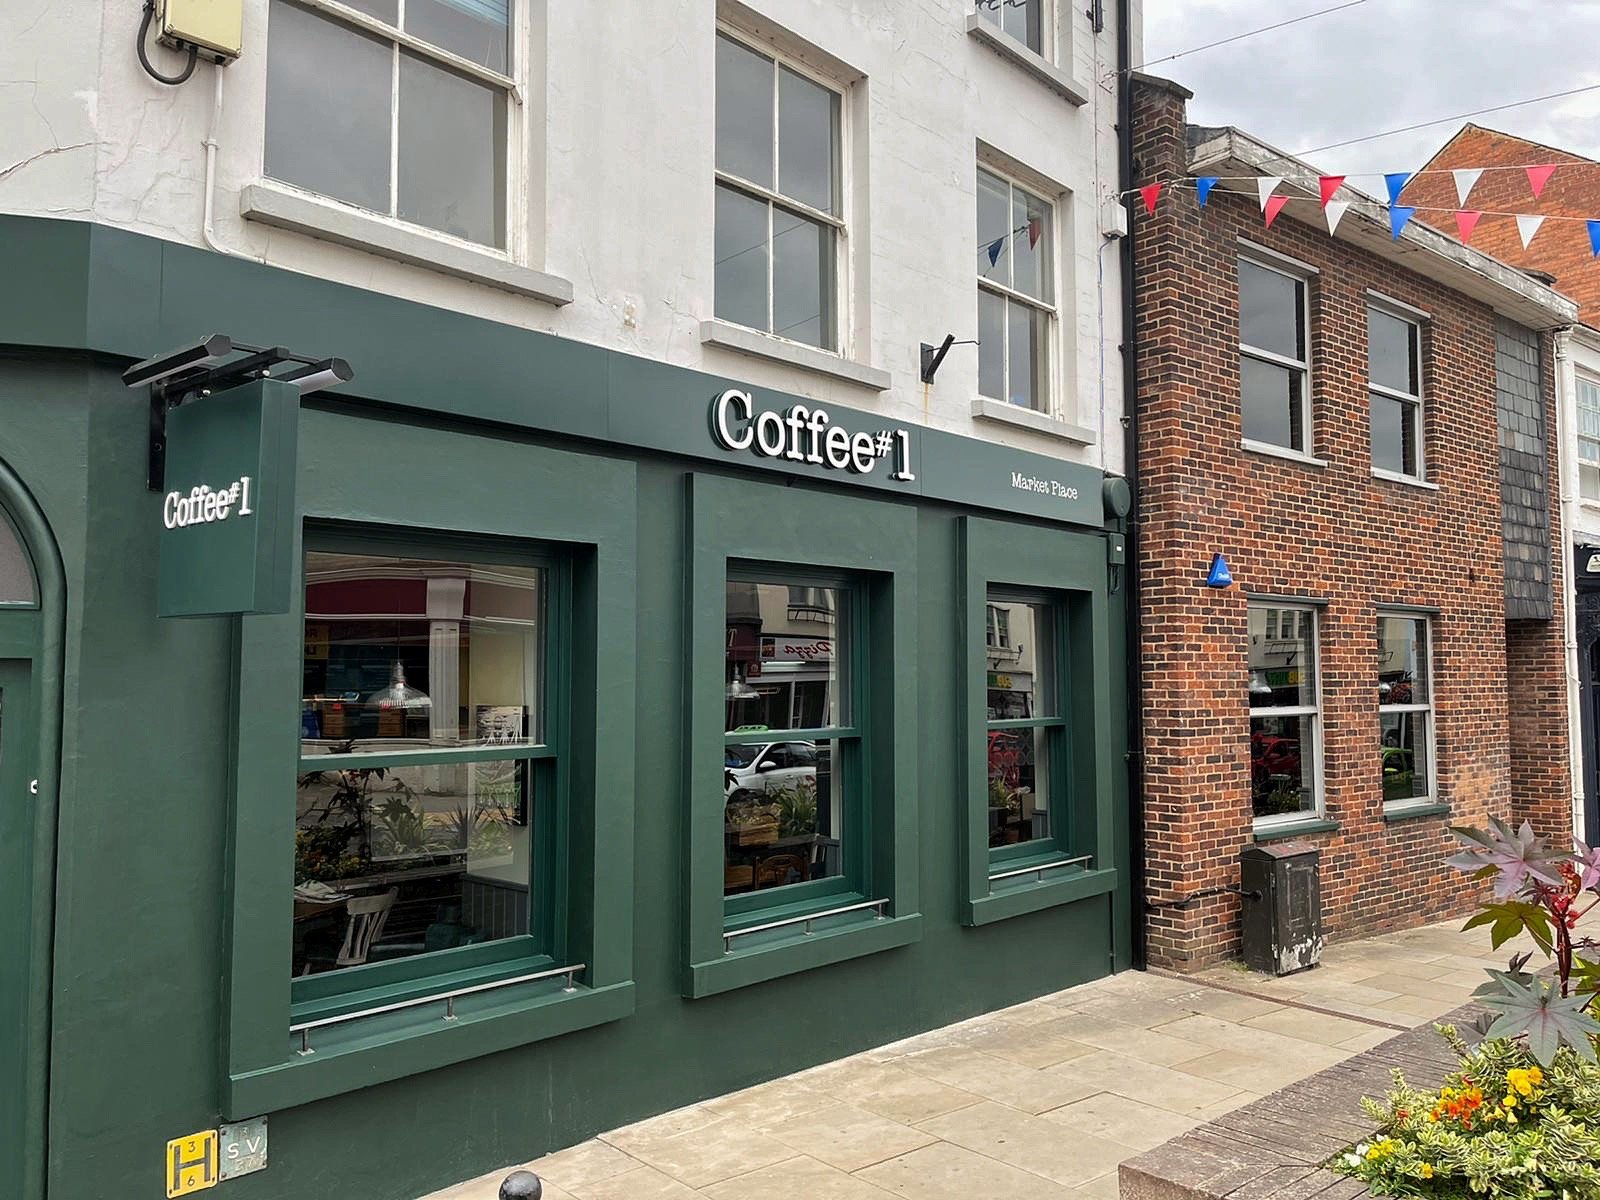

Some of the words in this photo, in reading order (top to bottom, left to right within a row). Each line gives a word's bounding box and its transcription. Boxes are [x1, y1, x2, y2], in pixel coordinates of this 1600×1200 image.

[1011, 471, 1049, 494] Market
[1051, 480, 1078, 499] Place
[188, 1141, 196, 1153] 3
[174, 1137, 211, 1191] H
[187, 1175, 196, 1187] 6
